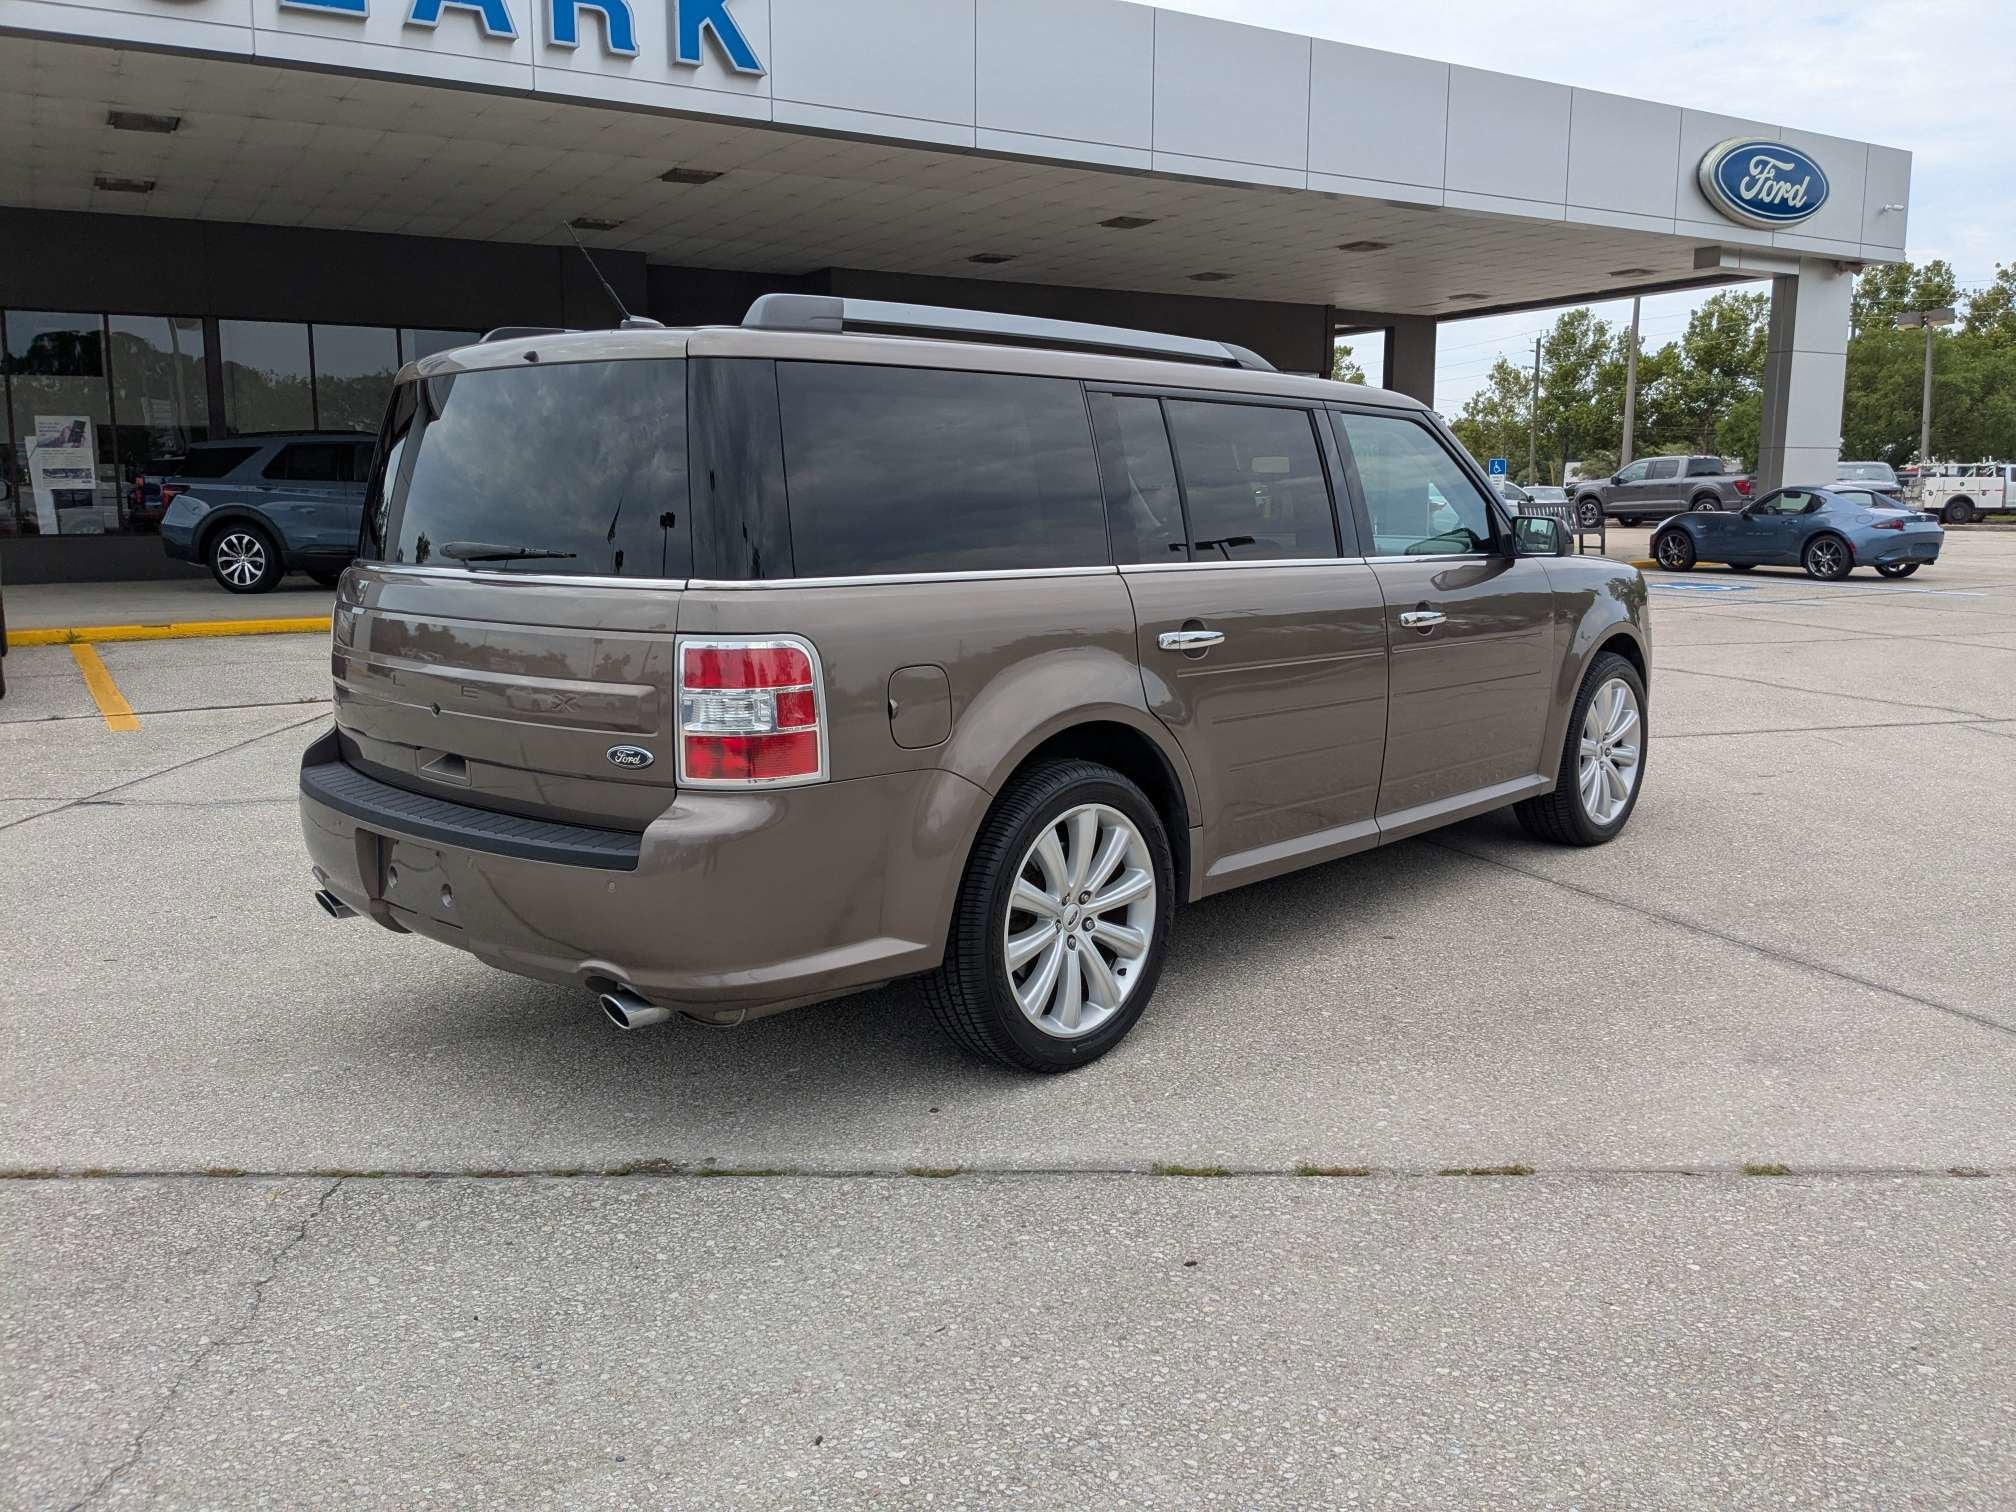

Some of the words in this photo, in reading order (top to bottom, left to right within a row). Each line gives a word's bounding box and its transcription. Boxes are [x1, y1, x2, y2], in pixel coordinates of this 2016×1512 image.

[278, 0, 766, 76] RK
[1740, 155, 1811, 208] Ford
[614, 750, 641, 764] Ford
